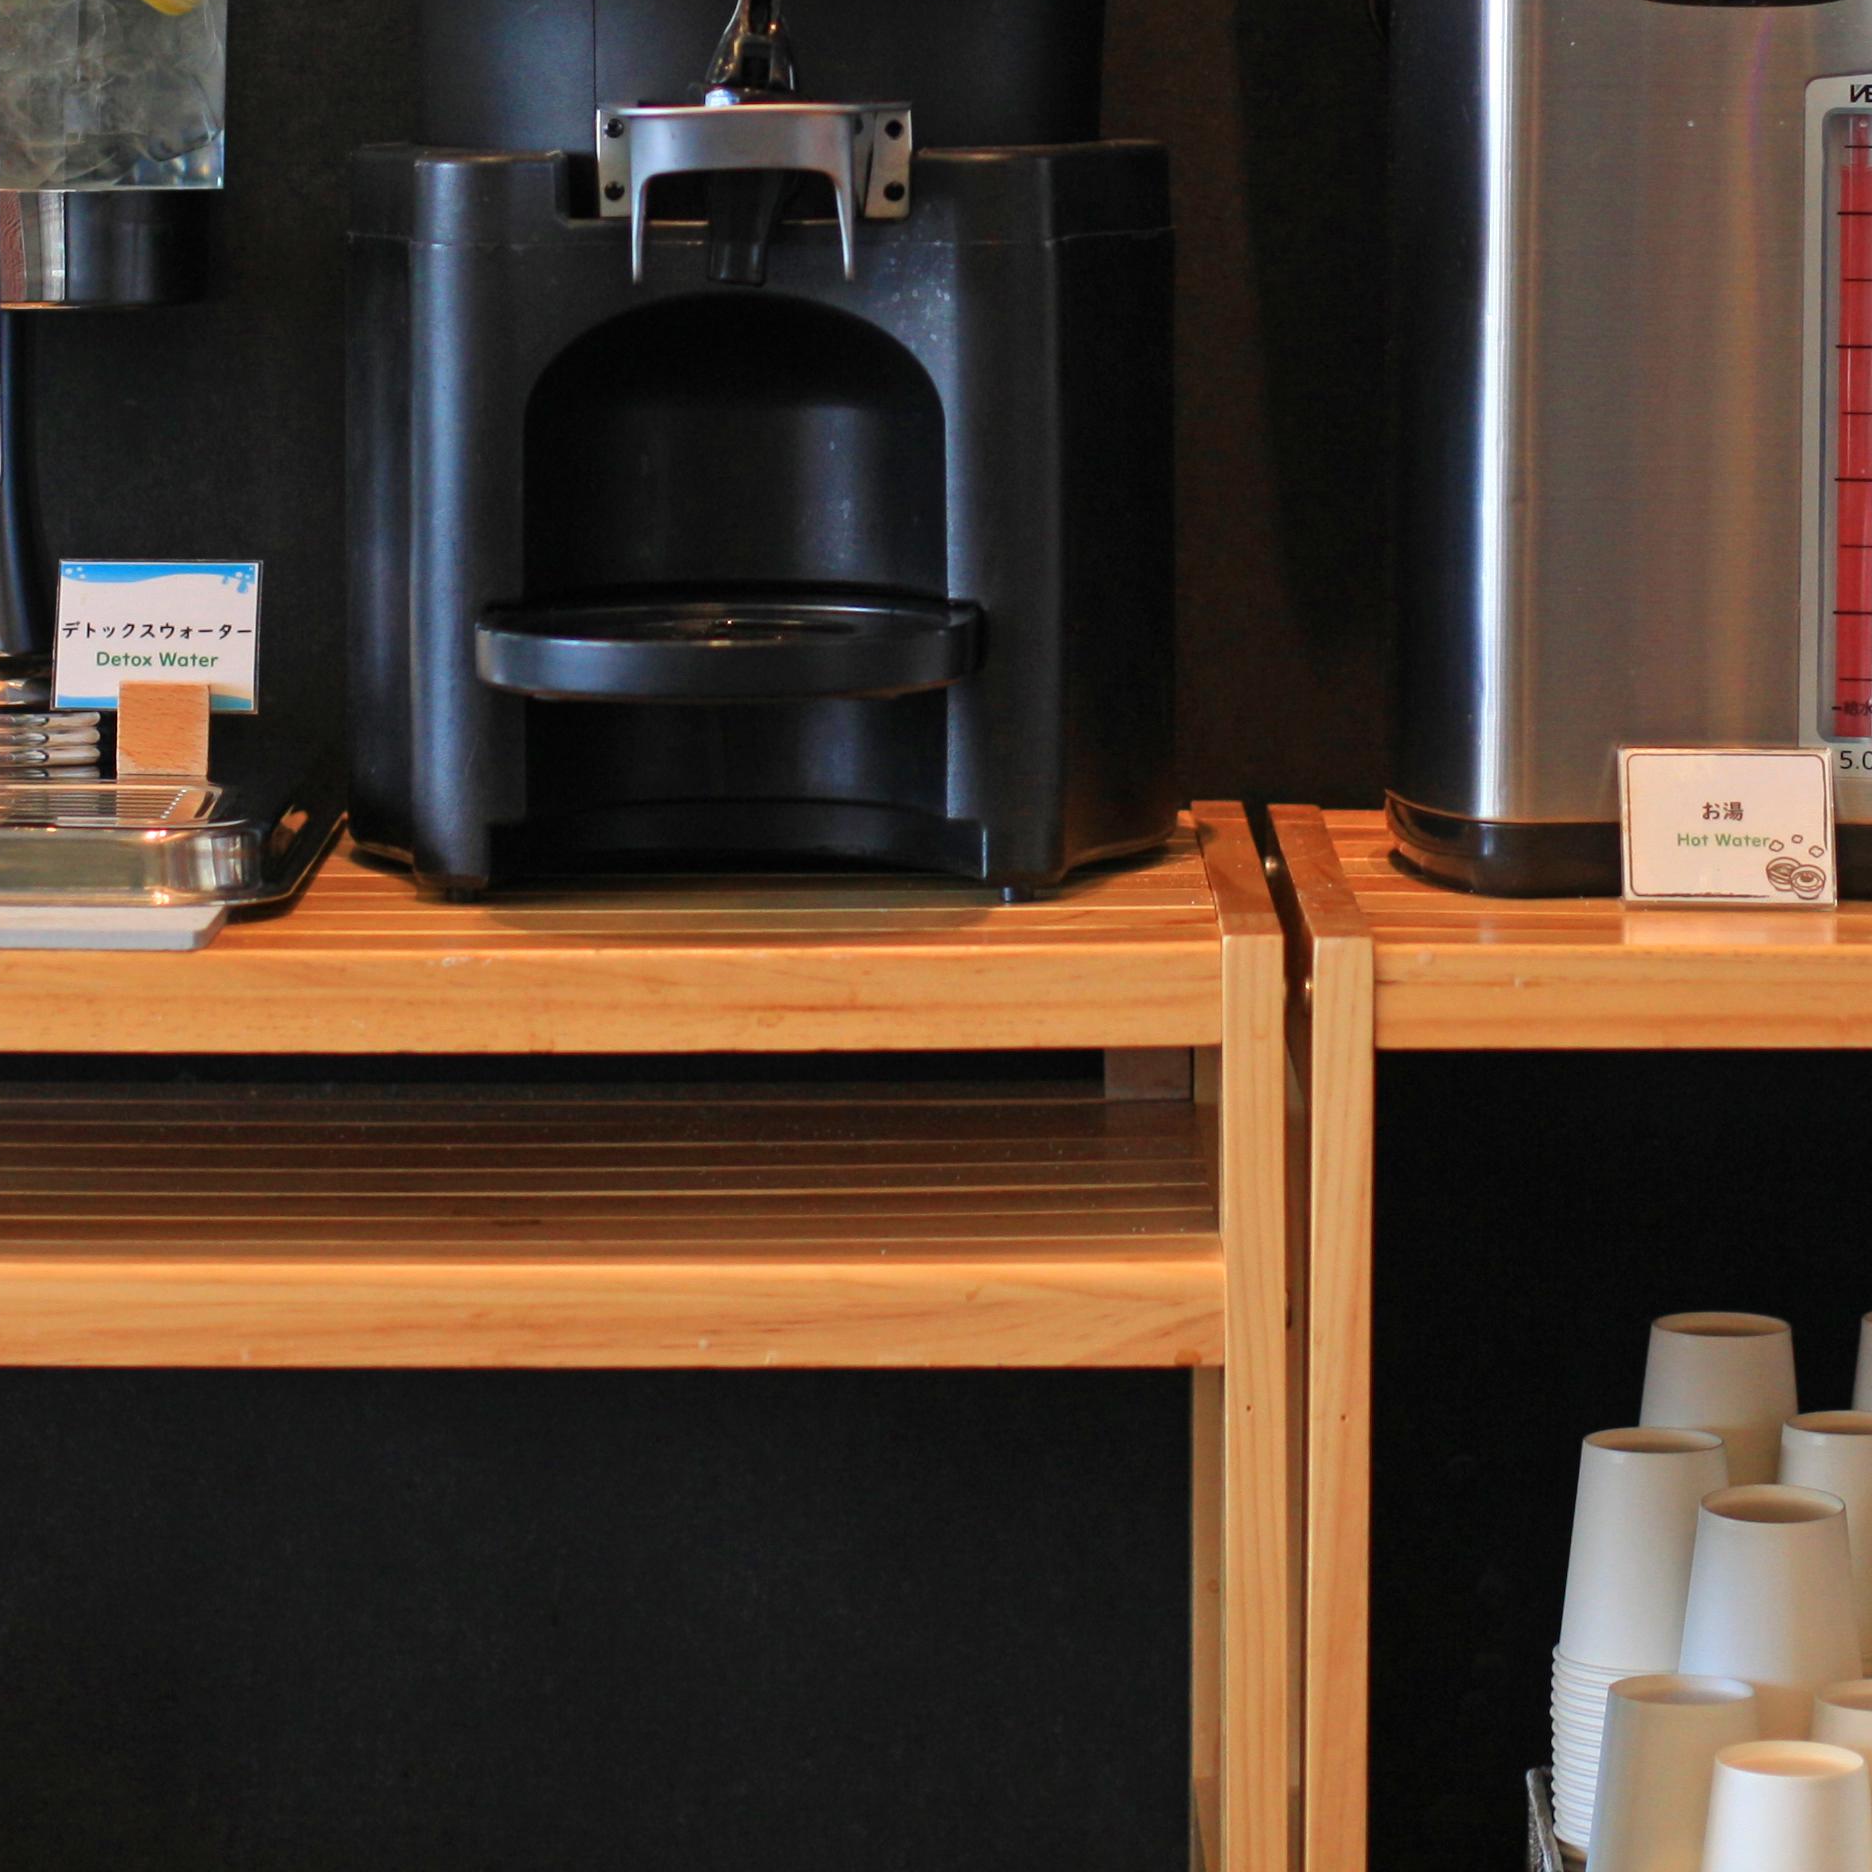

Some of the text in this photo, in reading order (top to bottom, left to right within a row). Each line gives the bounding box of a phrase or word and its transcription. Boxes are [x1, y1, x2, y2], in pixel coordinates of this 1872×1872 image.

[62, 620, 253, 640] デトックスウォーター
[96, 651, 219, 668] Detox Water
[1701, 801, 1744, 822] お湯
[1677, 832, 1770, 848] Hot Water
